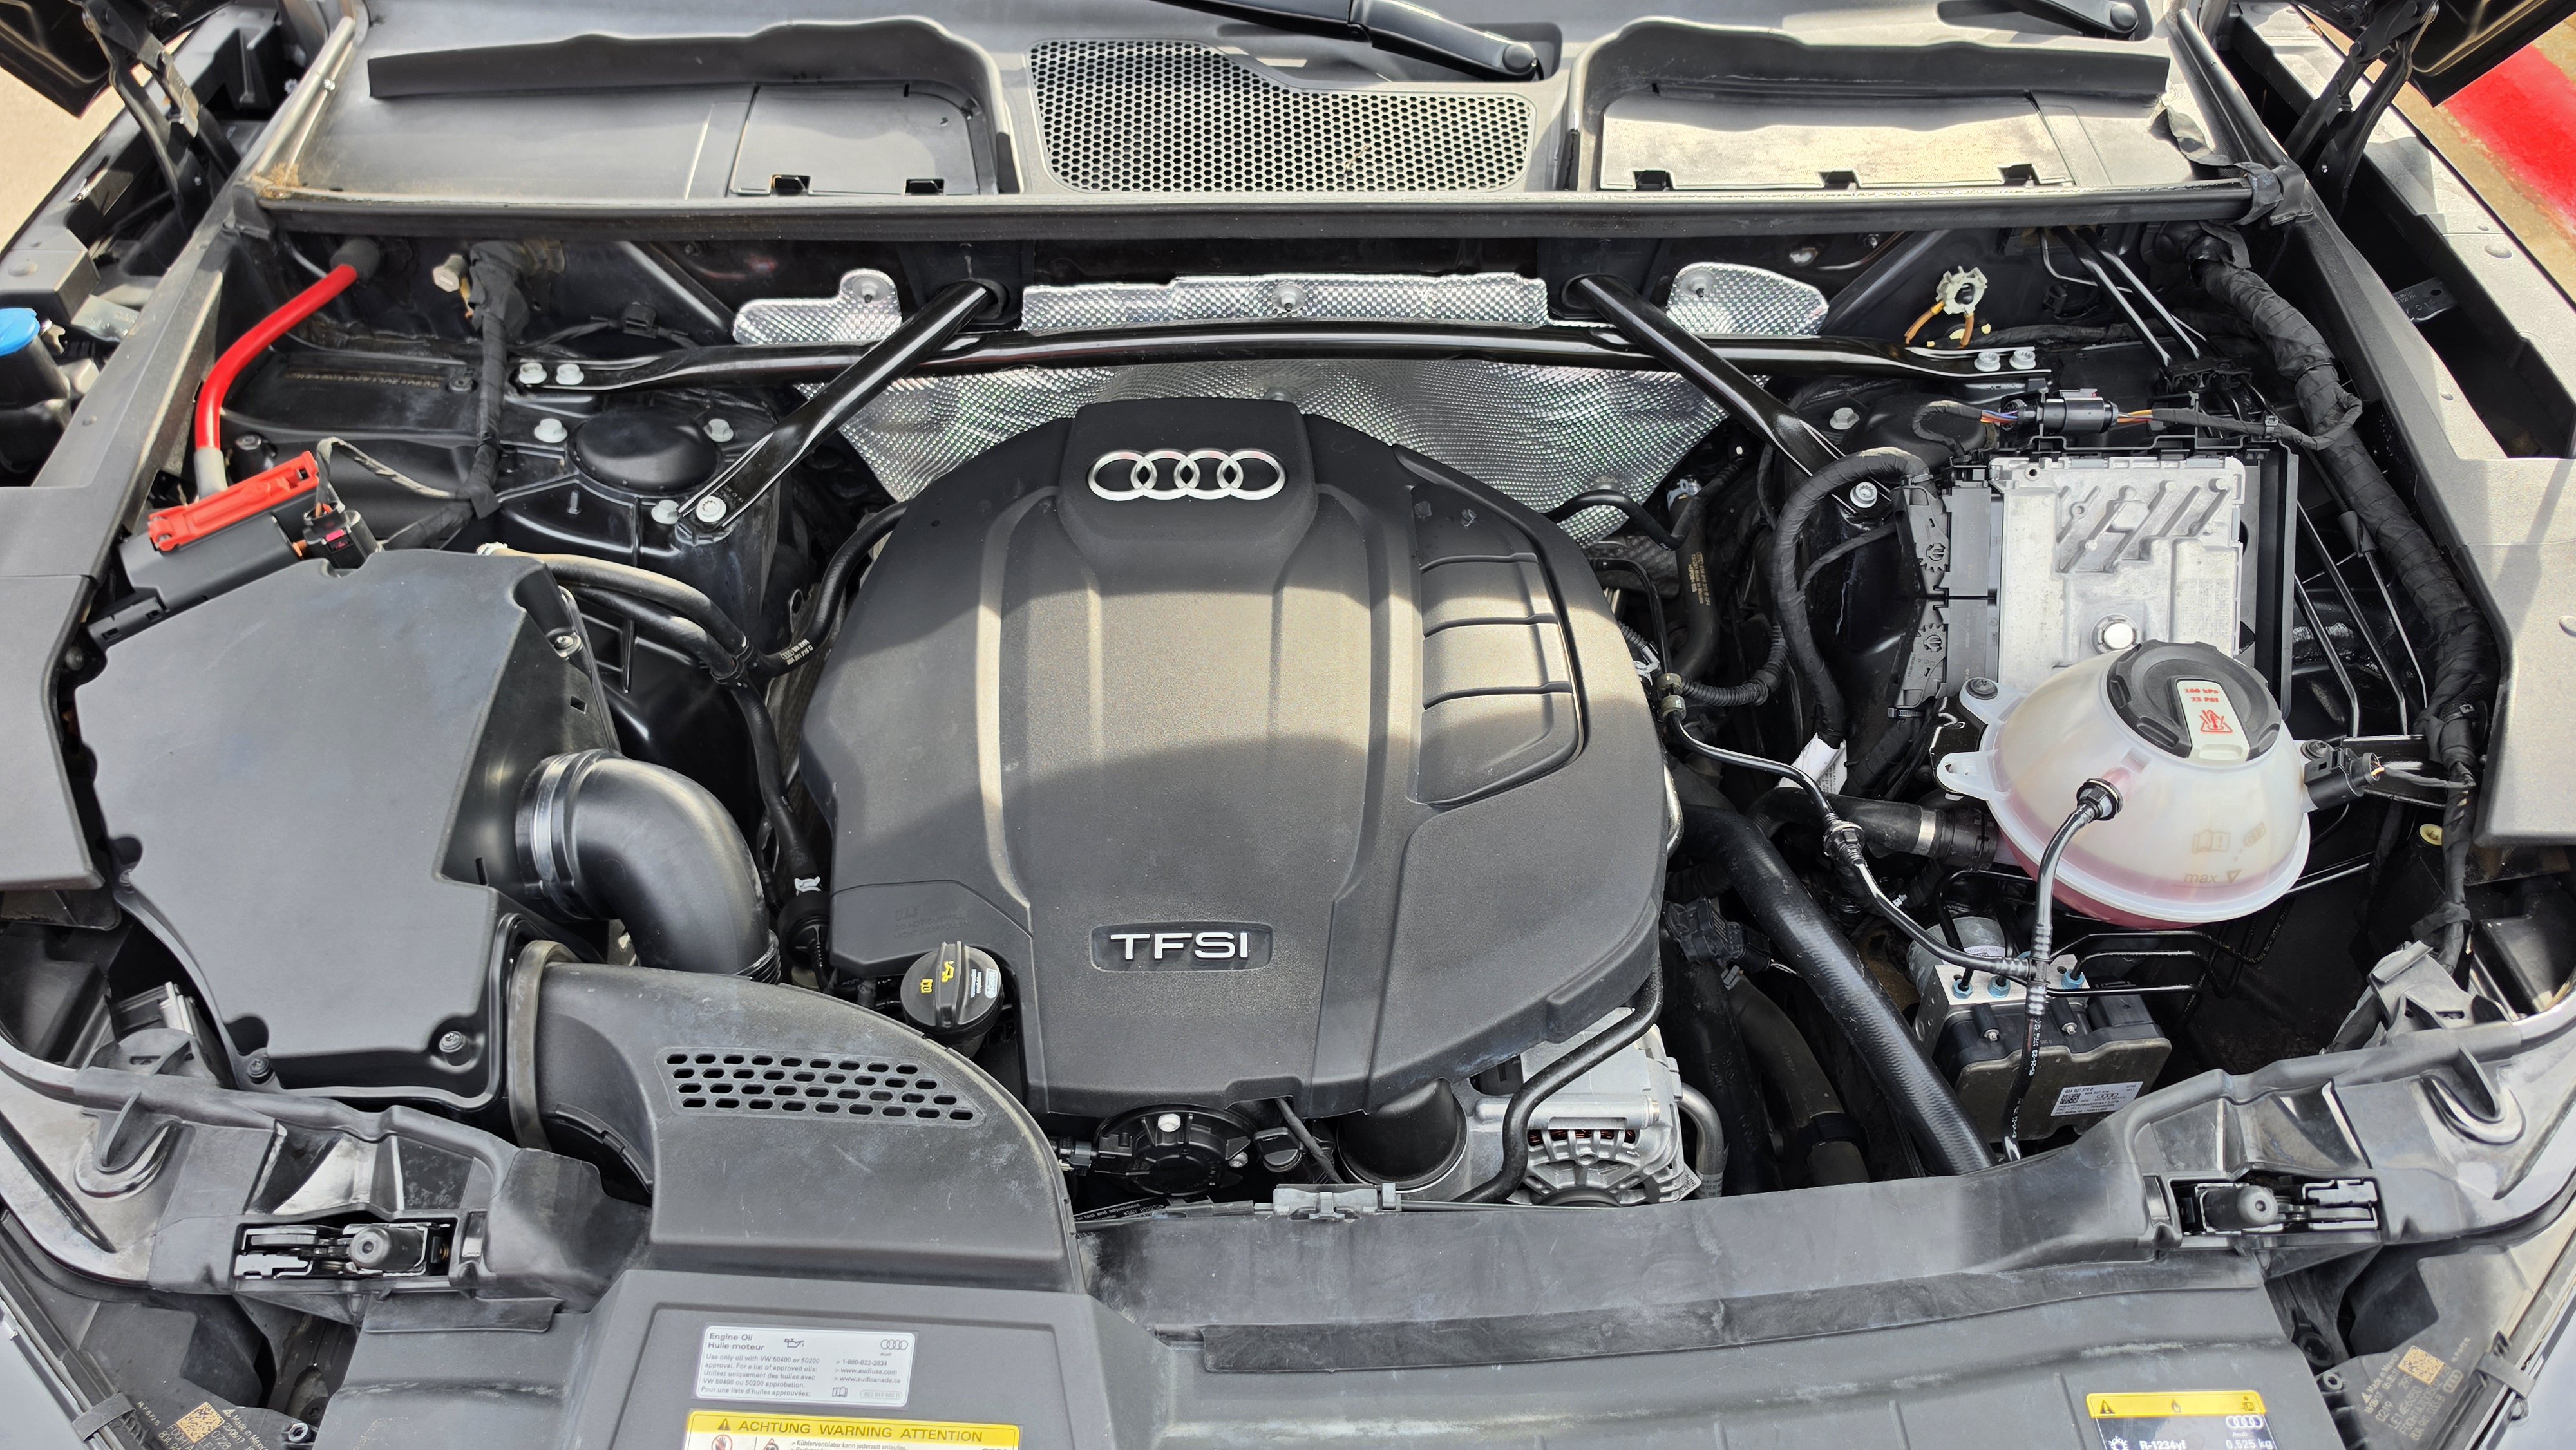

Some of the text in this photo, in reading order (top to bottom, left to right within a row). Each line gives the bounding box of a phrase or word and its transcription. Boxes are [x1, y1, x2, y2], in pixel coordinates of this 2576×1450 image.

[2184, 874, 2218, 883] max
[1111, 932, 1248, 959] TFSI
[2367, 1377, 2383, 1393] Made
[2382, 1353, 2400, 1372] Mexico
[224, 1423, 245, 1444] 23/08/17
[231, 1414, 246, 1431] Made
[245, 1427, 252, 1436] in
[738, 1420, 983, 1443] ACHTUNG WARNING ATTENTION
[211, 1430, 232, 1450] 0728
[2139, 1438, 2272, 1450] R-1234yf 0,525 kg
